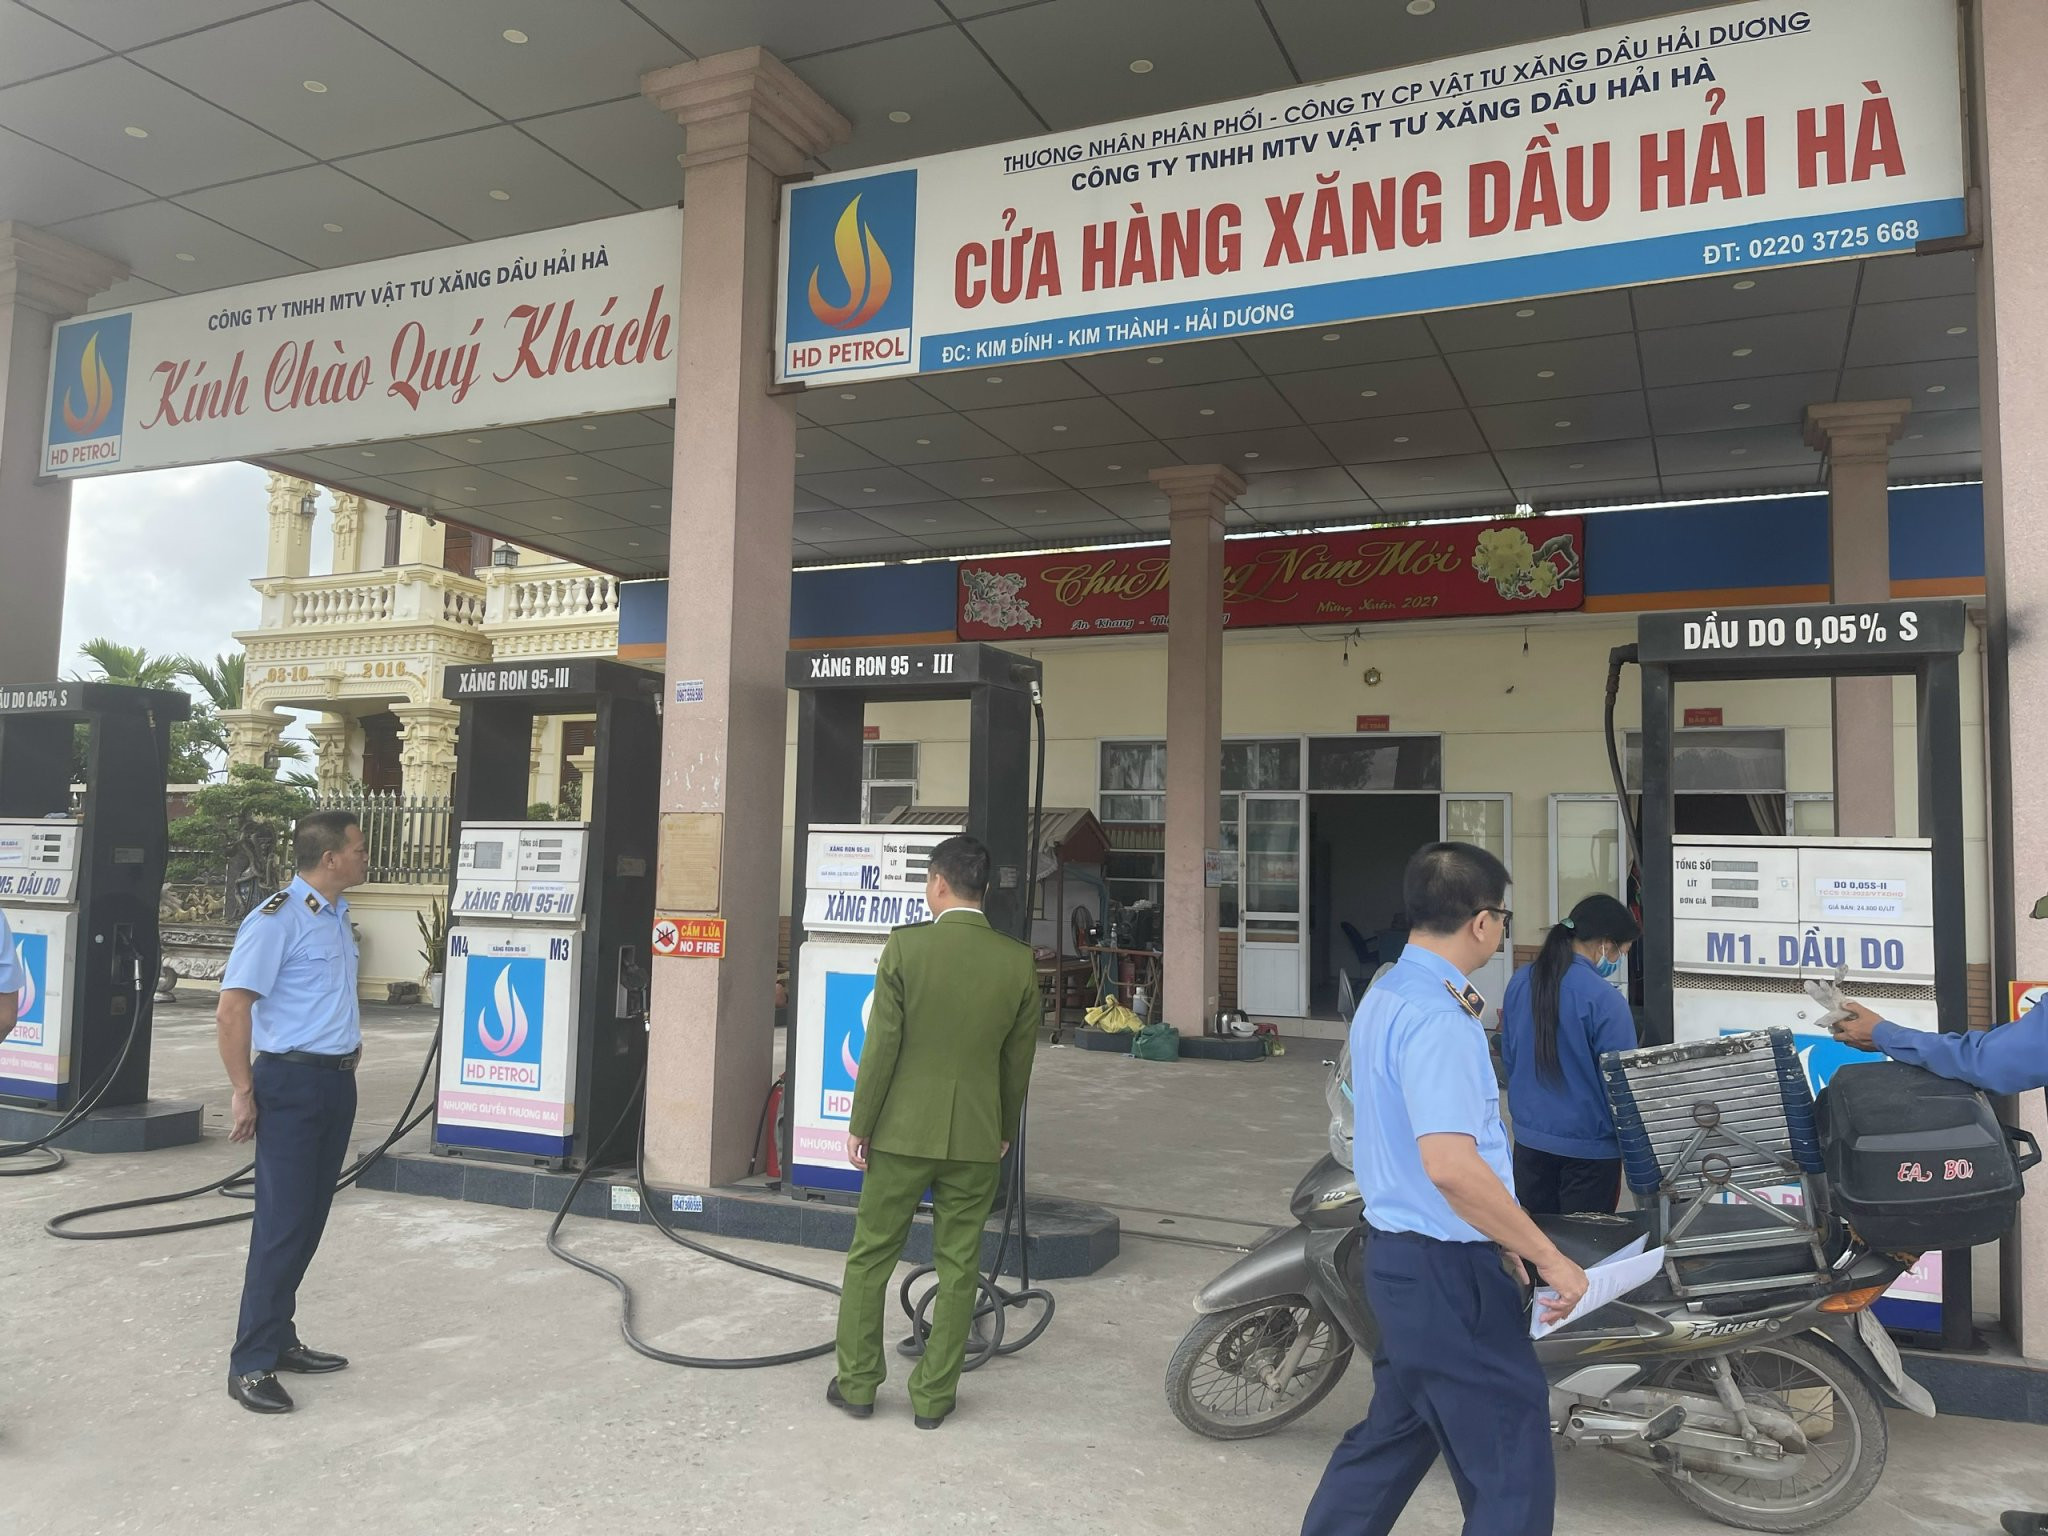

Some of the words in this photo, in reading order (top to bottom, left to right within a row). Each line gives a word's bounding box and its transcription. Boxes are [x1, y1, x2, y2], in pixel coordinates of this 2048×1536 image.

[1003, 144, 1083, 172] THƯƠNG
[1089, 132, 1145, 157] NHÂN
[1152, 122, 1207, 146] PHÂN
[1213, 107, 1262, 136] PHỐI
[1284, 99, 1355, 123] CÔNG
[1361, 90, 1385, 110] TY
[1391, 83, 1422, 104] CP
[1429, 72, 1474, 98] VẬT
[1480, 66, 1506, 87] TƯ
[1513, 52, 1588, 82] XĂNG
[1596, 36, 1648, 66] DẦU
[1657, 25, 1700, 54] HẢI
[1710, 11, 1811, 45] DƯƠNG
[1071, 165, 1139, 191] CÔNG
[1147, 157, 1178, 178] TY
[1186, 145, 1254, 173] TNHH
[1262, 133, 1318, 160] MTV
[1327, 121, 1382, 151] VẬT
[1390, 112, 1429, 138] TƯ
[1436, 98, 1520, 131] XĂNG
[1531, 78, 1596, 113] DẦU
[1607, 66, 1660, 100] HẢI
[1671, 57, 1716, 87] HÀ
[954, 207, 1063, 309] CỬA
[1081, 202, 1242, 293] HÀNG
[1263, 170, 1442, 268] XĂNG
[1468, 122, 1610, 238] DẦU
[1639, 86, 1767, 212] HẢI
[1797, 80, 1907, 189] HÀ
[1703, 241, 1741, 265] ĐT:
[1749, 233, 1804, 259] 0220
[1813, 226, 1869, 250] 3725
[1876, 219, 1919, 244] 668
[208, 309, 252, 331] CÔNG
[257, 304, 277, 322] TY
[281, 297, 325, 318] TNHH
[330, 290, 366, 311] MTV
[371, 281, 405, 308] VẬT
[410, 277, 435, 298] TƯ
[438, 269, 491, 294] XĂNG
[496, 256, 537, 284] DẦU
[543, 248, 576, 276] HẢI
[582, 245, 609, 270] HÀ
[942, 345, 971, 363] ĐC:
[976, 341, 1007, 358] KIM
[1011, 327, 1053, 356] ĐÍNH
[1068, 327, 1100, 347] KIM
[1105, 314, 1168, 342] THÀNH
[1185, 308, 1219, 333] HẢI
[1223, 302, 1295, 328] DƯƠNG
[139, 341, 249, 431] Kính
[264, 339, 375, 414] Chào
[386, 312, 481, 412] Quý
[492, 284, 672, 383] Khách
[791, 348, 822, 370] HD
[829, 336, 905, 366] PETROL
[50, 449, 67, 465] HD
[72, 442, 117, 463] PETROL
[1041, 559, 1148, 606] Chúc
[1338, 540, 1461, 587] Mới
[1071, 620, 1090, 631] An
[1095, 618, 1134, 630] Khang
[1683, 611, 1740, 650] DẦU
[1748, 618, 1786, 647] DO
[1795, 613, 1888, 648] 0,05%
[1899, 611, 1918, 642] S
[810, 654, 851, 678] XĂNG
[855, 656, 886, 677] RON
[890, 655, 909, 676] 95
[933, 653, 953, 674] III
[459, 668, 496, 692] XĂNG
[499, 669, 528, 691] RON
[531, 667, 570, 689] 95-III
[12, 691, 25, 708] DO
[27, 690, 57, 708] 0.05%
[60, 689, 68, 706] S
[1675, 857, 1697, 870] TỔNG
[1699, 858, 1711, 871] SỐ
[17, 871, 43, 895] DẦU
[43, 877, 61, 896] DO
[860, 865, 880, 890] M2
[1834, 881, 1846, 889] DO
[461, 888, 500, 910] XĂNG
[502, 892, 533, 913] RON
[535, 893, 574, 914] 95-III
[824, 891, 867, 921] XĂNG
[869, 896, 902, 924] RON
[905, 898, 930, 924] 95-
[681, 923, 701, 938] CẤM
[702, 922, 720, 938] LỬA
[451, 935, 468, 957] M4
[550, 938, 569, 961] M3
[680, 941, 694, 953] NO
[697, 942, 720, 954] FIRE
[1707, 931, 1766, 965] M1.
[1778, 926, 1846, 969] DẦU
[1861, 937, 1904, 971] DO
[13, 1025, 40, 1040] ETROL
[466, 1064, 486, 1079] HD
[489, 1065, 536, 1085] PETROL
[827, 1095, 850, 1113] HD
[1903, 1265, 1928, 1284] ẠI
